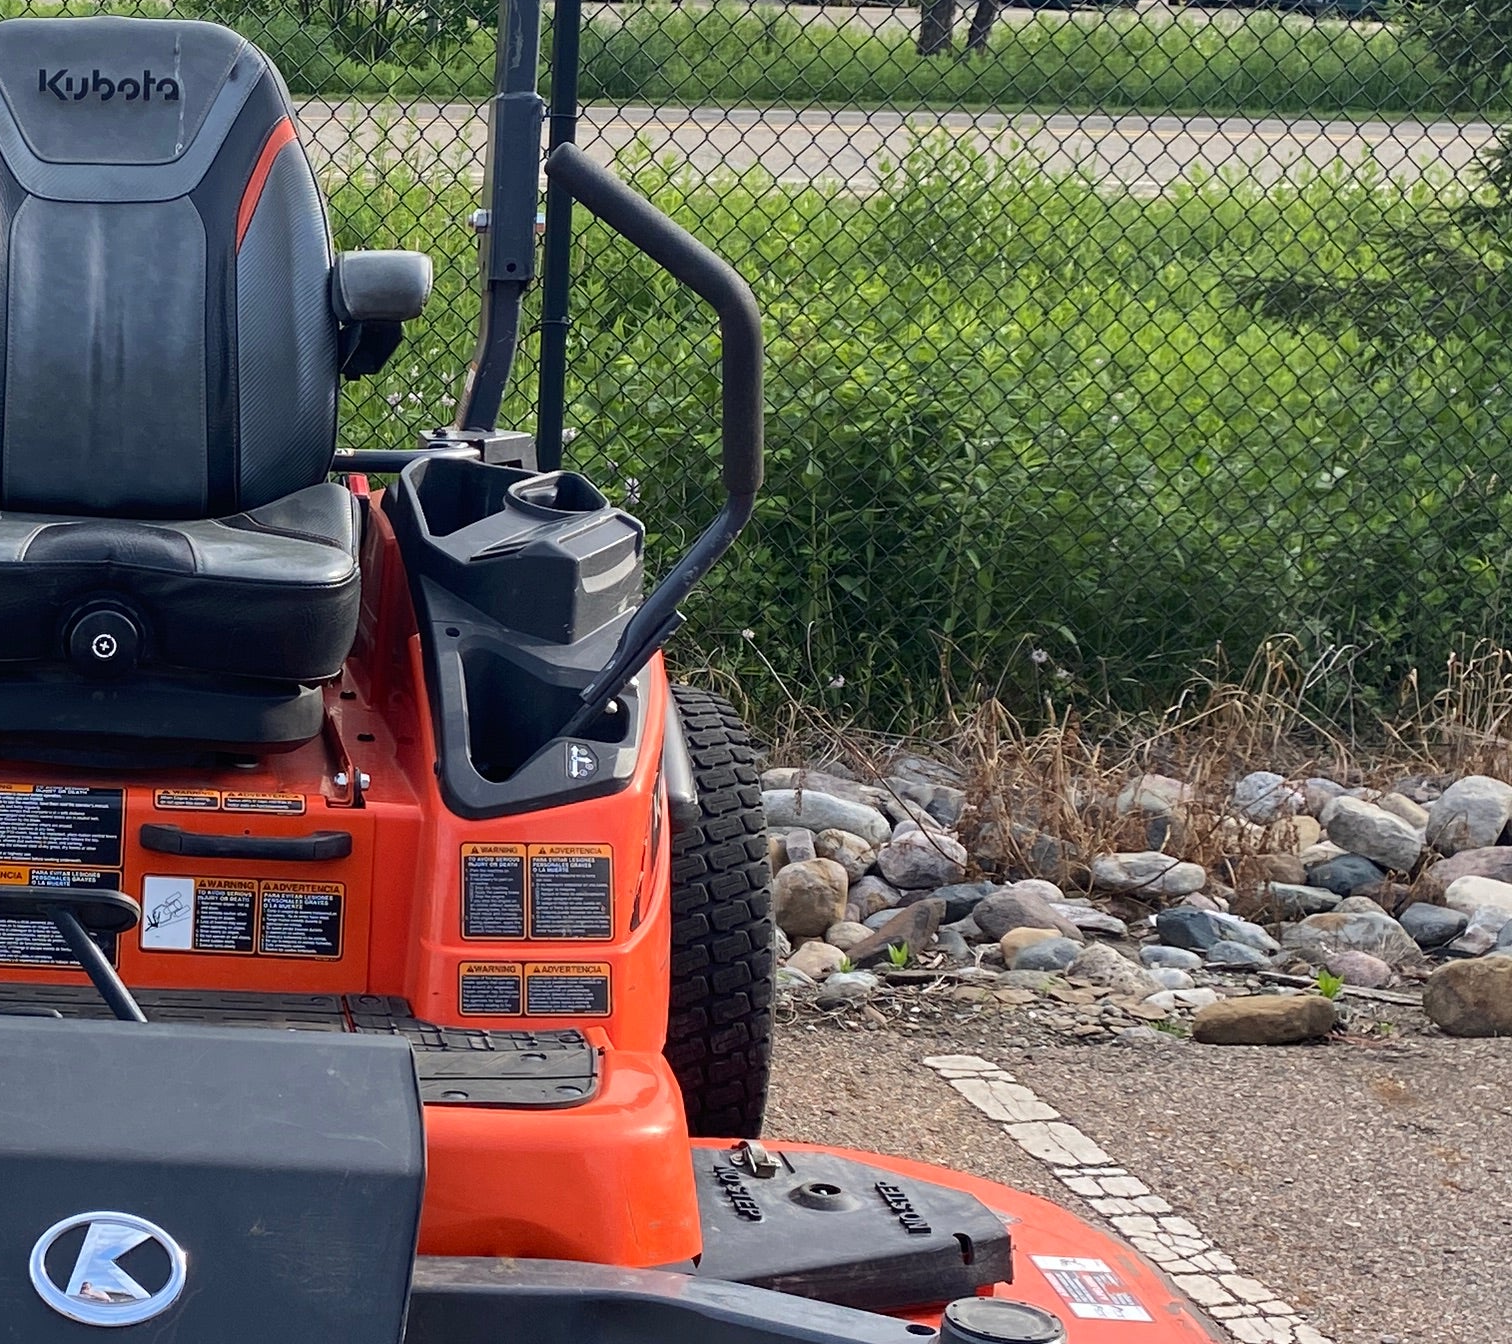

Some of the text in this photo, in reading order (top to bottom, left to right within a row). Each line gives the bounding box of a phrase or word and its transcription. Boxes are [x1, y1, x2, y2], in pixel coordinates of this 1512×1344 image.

[39, 69, 179, 101] Kubota
[481, 846, 518, 854] WARNING
[208, 881, 255, 890] WARNING
[273, 883, 340, 894] ADVERTENCIA
[474, 965, 516, 973] WARNING
[541, 966, 602, 974] ADVERTENCIA
[713, 1165, 763, 1222] NO STEP
[899, 1211, 932, 1234] NO
